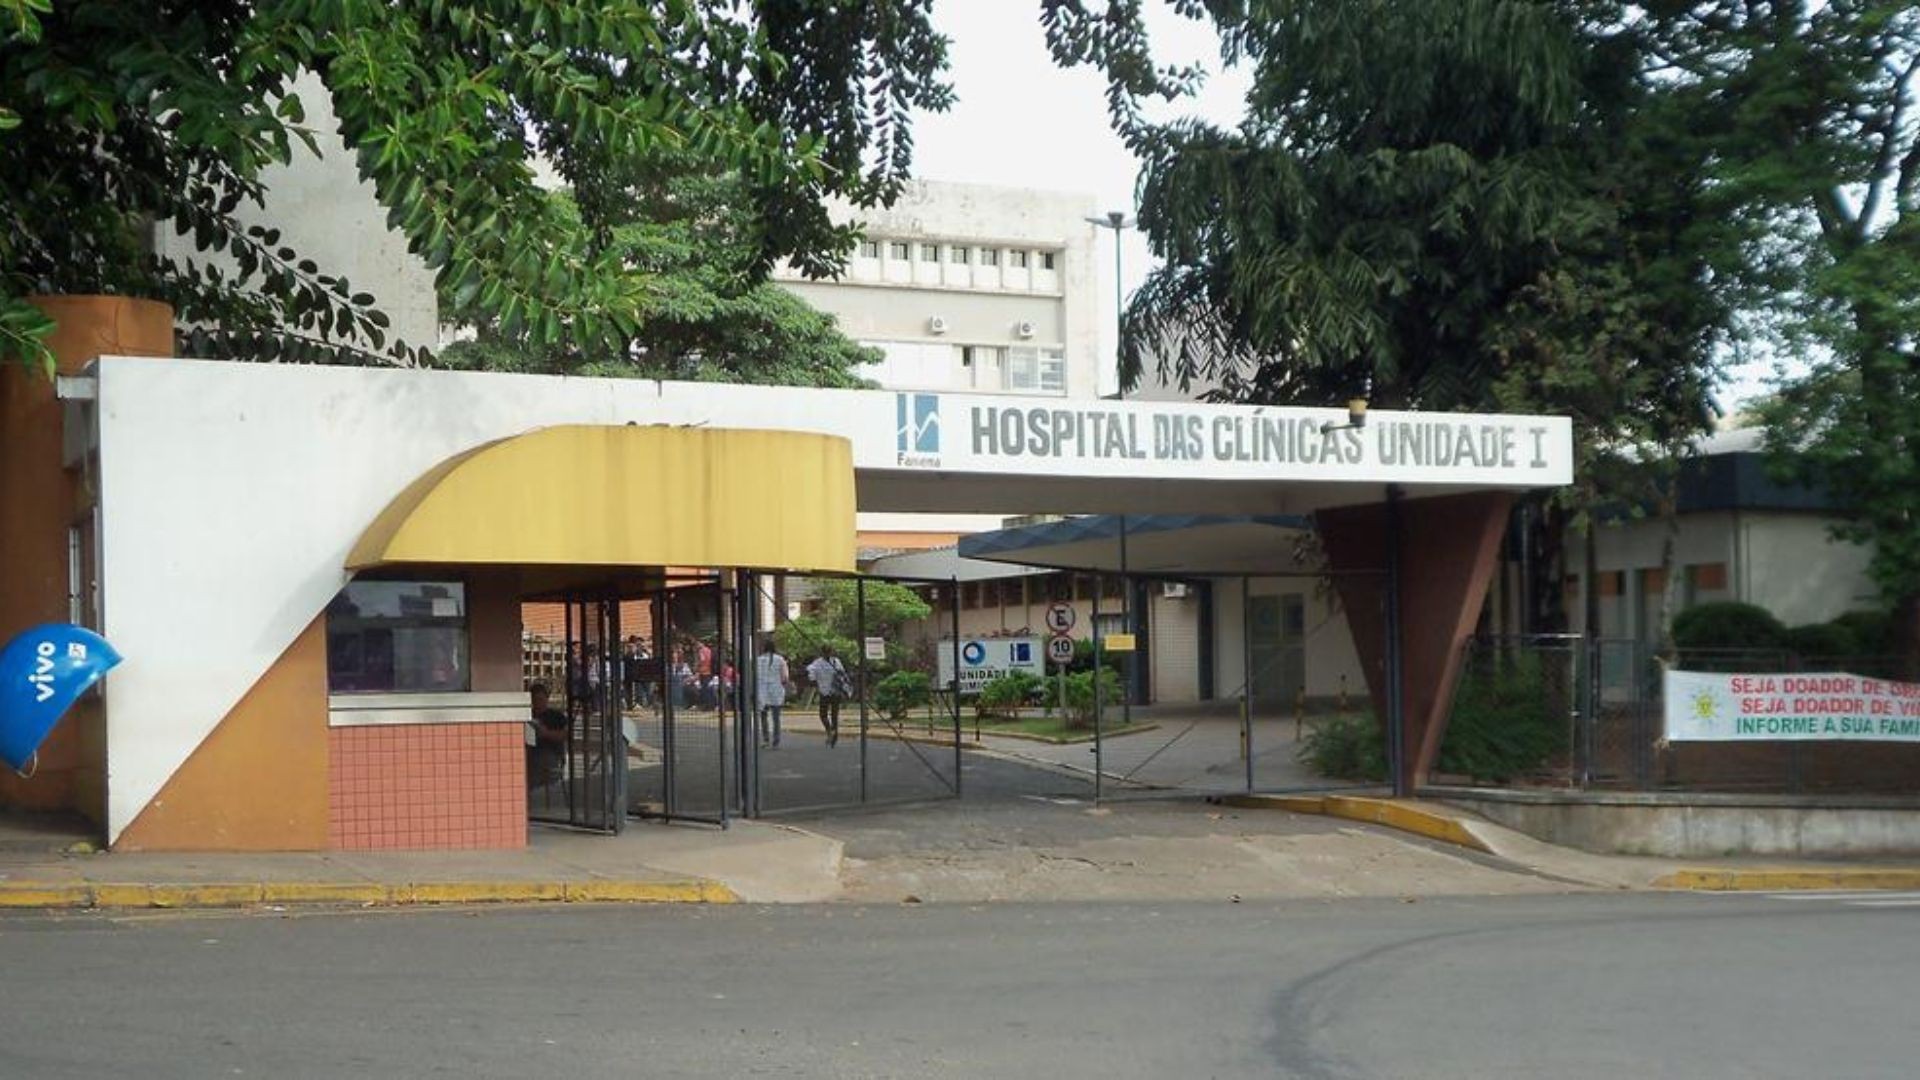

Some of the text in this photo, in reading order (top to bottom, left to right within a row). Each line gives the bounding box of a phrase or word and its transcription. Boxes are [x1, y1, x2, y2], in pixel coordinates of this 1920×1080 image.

[972, 407, 1548, 468] HOSPITAL DAS CLÍNICAS UNIDADE I
[1053, 640, 1070, 653] 10
[28, 641, 56, 702] vivo
[1731, 678, 1776, 693] SEJA
[1784, 678, 1856, 694] DOADOR
[1862, 680, 1883, 695] DE
[1742, 698, 1787, 714] SEJA
[1794, 698, 1864, 714] DOADOR
[1871, 699, 1892, 715] DE
[1737, 717, 1818, 734] INFORME
[1824, 717, 1837, 732] A
[1841, 717, 1874, 733] SUA
